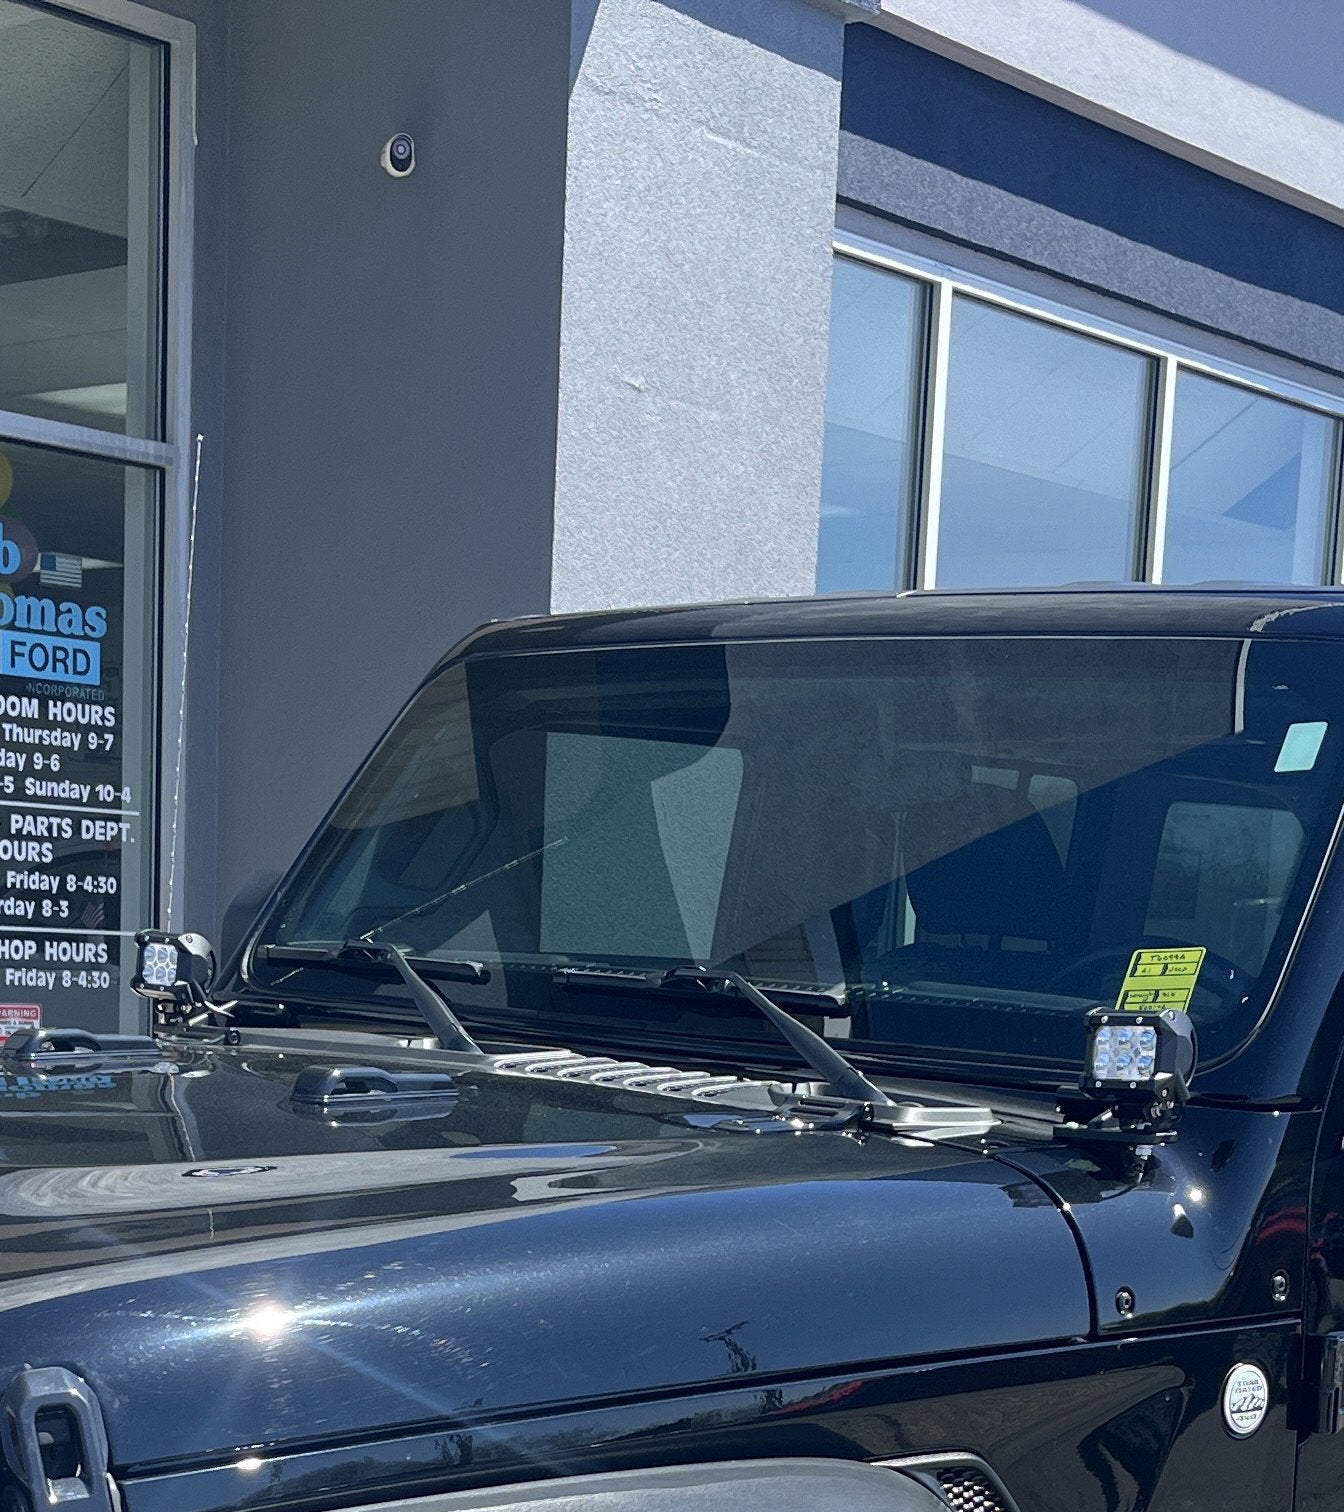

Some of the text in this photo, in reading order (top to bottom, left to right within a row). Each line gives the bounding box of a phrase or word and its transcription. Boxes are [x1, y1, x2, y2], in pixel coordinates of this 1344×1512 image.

[10, 640, 92, 676] FORD
[48, 700, 117, 728] HOURS
[2, 723, 82, 751] Thursday
[88, 731, 115, 752] 9-7
[33, 752, 61, 772] 9-6
[24, 777, 91, 803] Sunday
[95, 784, 133, 803] 10-4
[10, 814, 74, 840] PARTS
[81, 819, 136, 843] DEPT.
[6, 870, 61, 894] Friday
[66, 874, 118, 895] 8-4:30
[41, 900, 70, 920] 8-3
[44, 941, 109, 964] HOURS
[5, 968, 57, 990] Friday
[62, 970, 111, 990] 8-4:30
